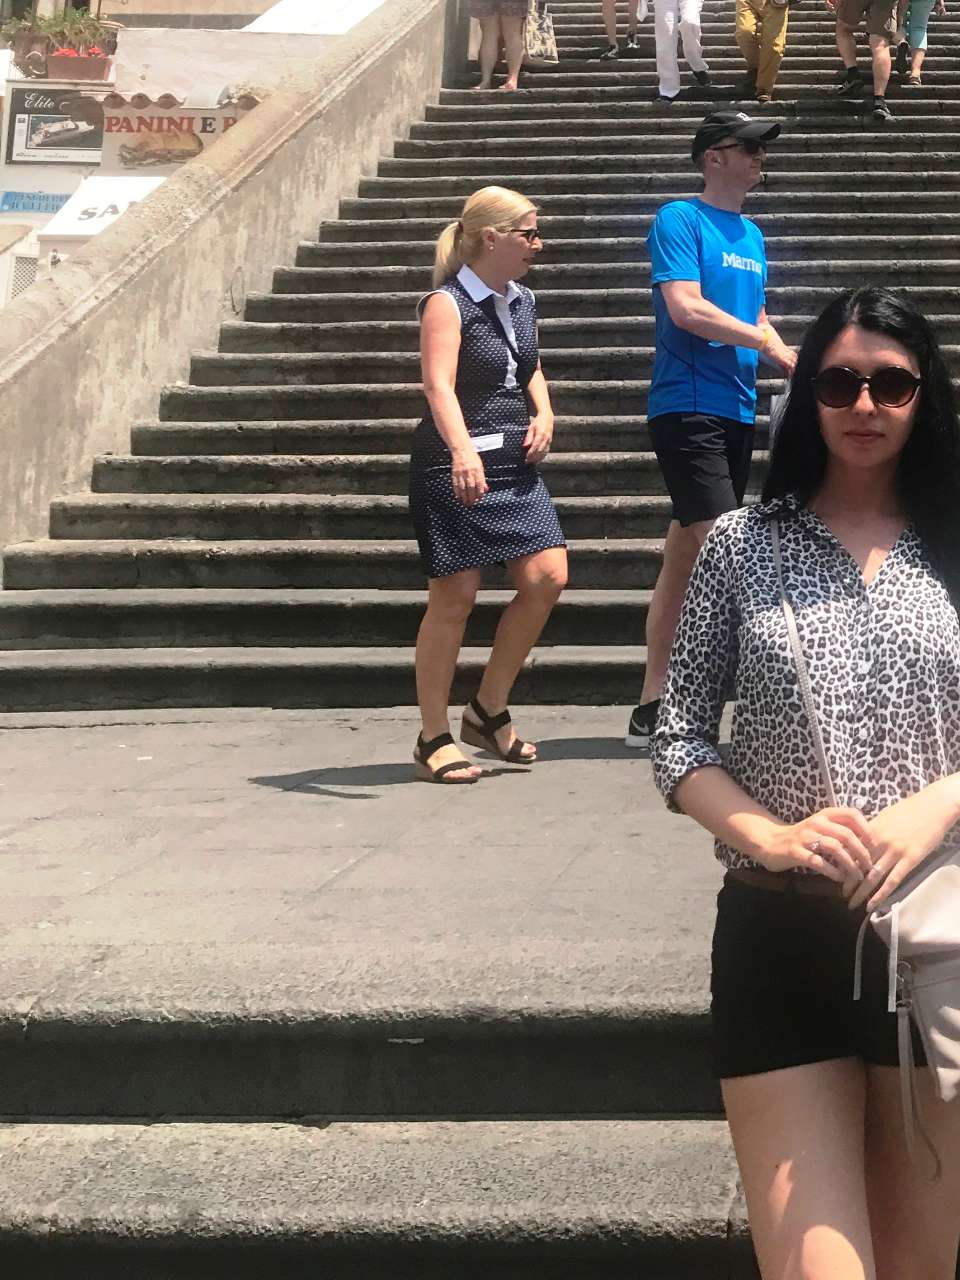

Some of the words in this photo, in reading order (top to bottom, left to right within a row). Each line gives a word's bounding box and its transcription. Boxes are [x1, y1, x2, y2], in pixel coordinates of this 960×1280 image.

[24, 92, 55, 109] Elite
[105, 116, 195, 133] PANINI
[200, 117, 216, 133] E
[78, 202, 129, 221] SA
